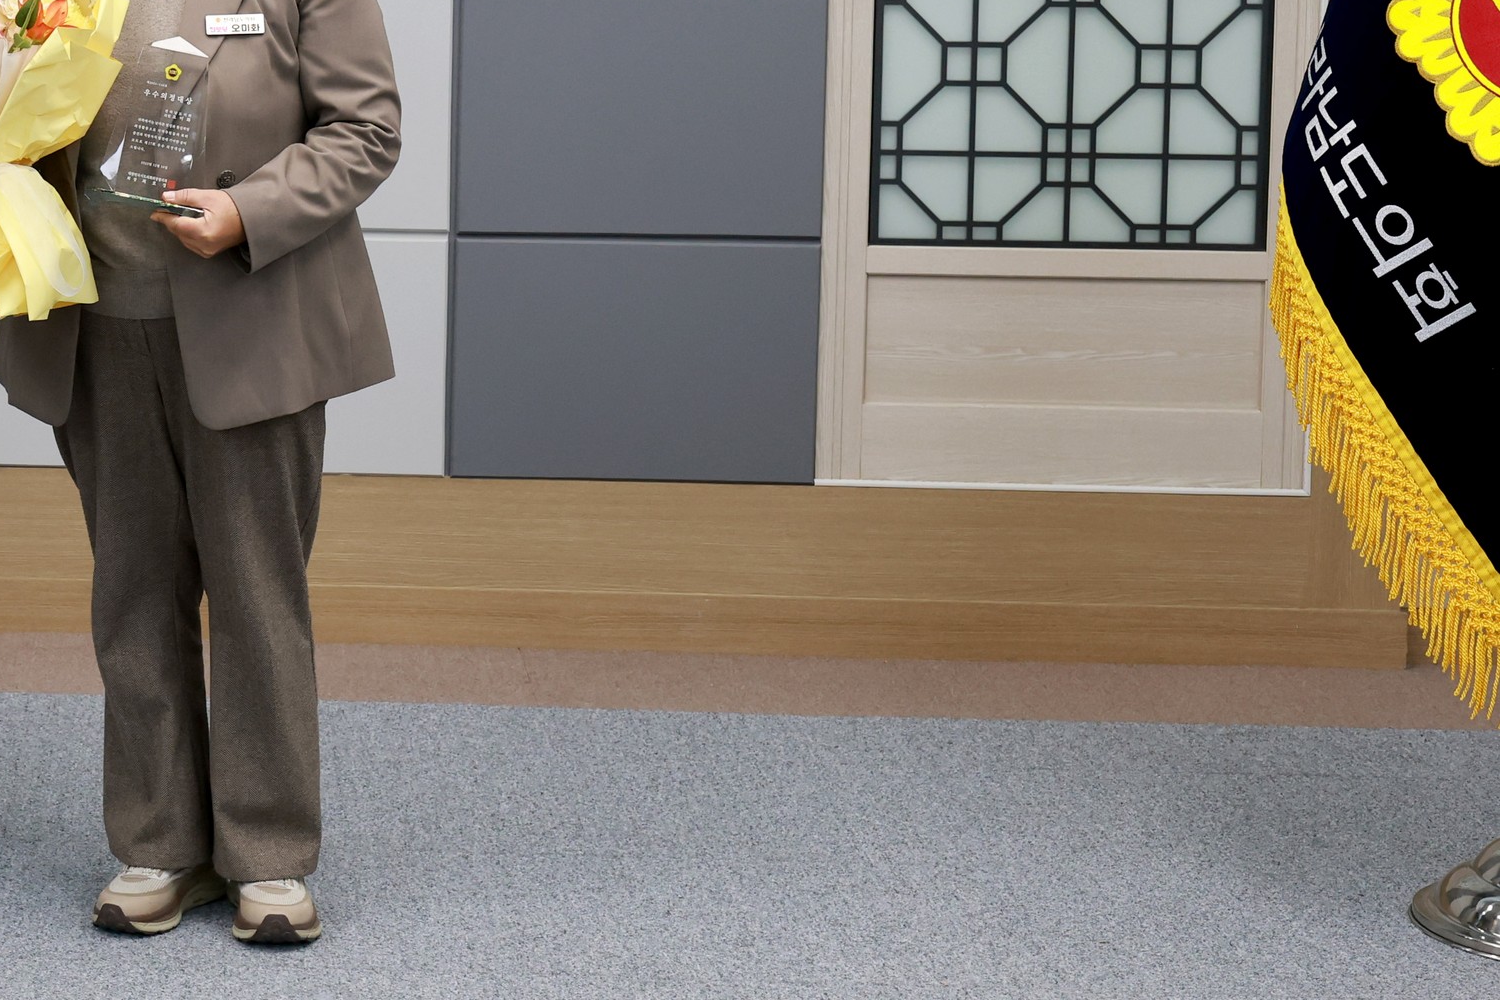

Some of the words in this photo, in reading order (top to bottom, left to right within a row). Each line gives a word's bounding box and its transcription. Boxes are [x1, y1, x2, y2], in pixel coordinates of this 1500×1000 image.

[231, 23, 260, 33] 오미화
[143, 88, 193, 105] 우수의정대상
[1301, 24, 1477, 342] 라남도의회
